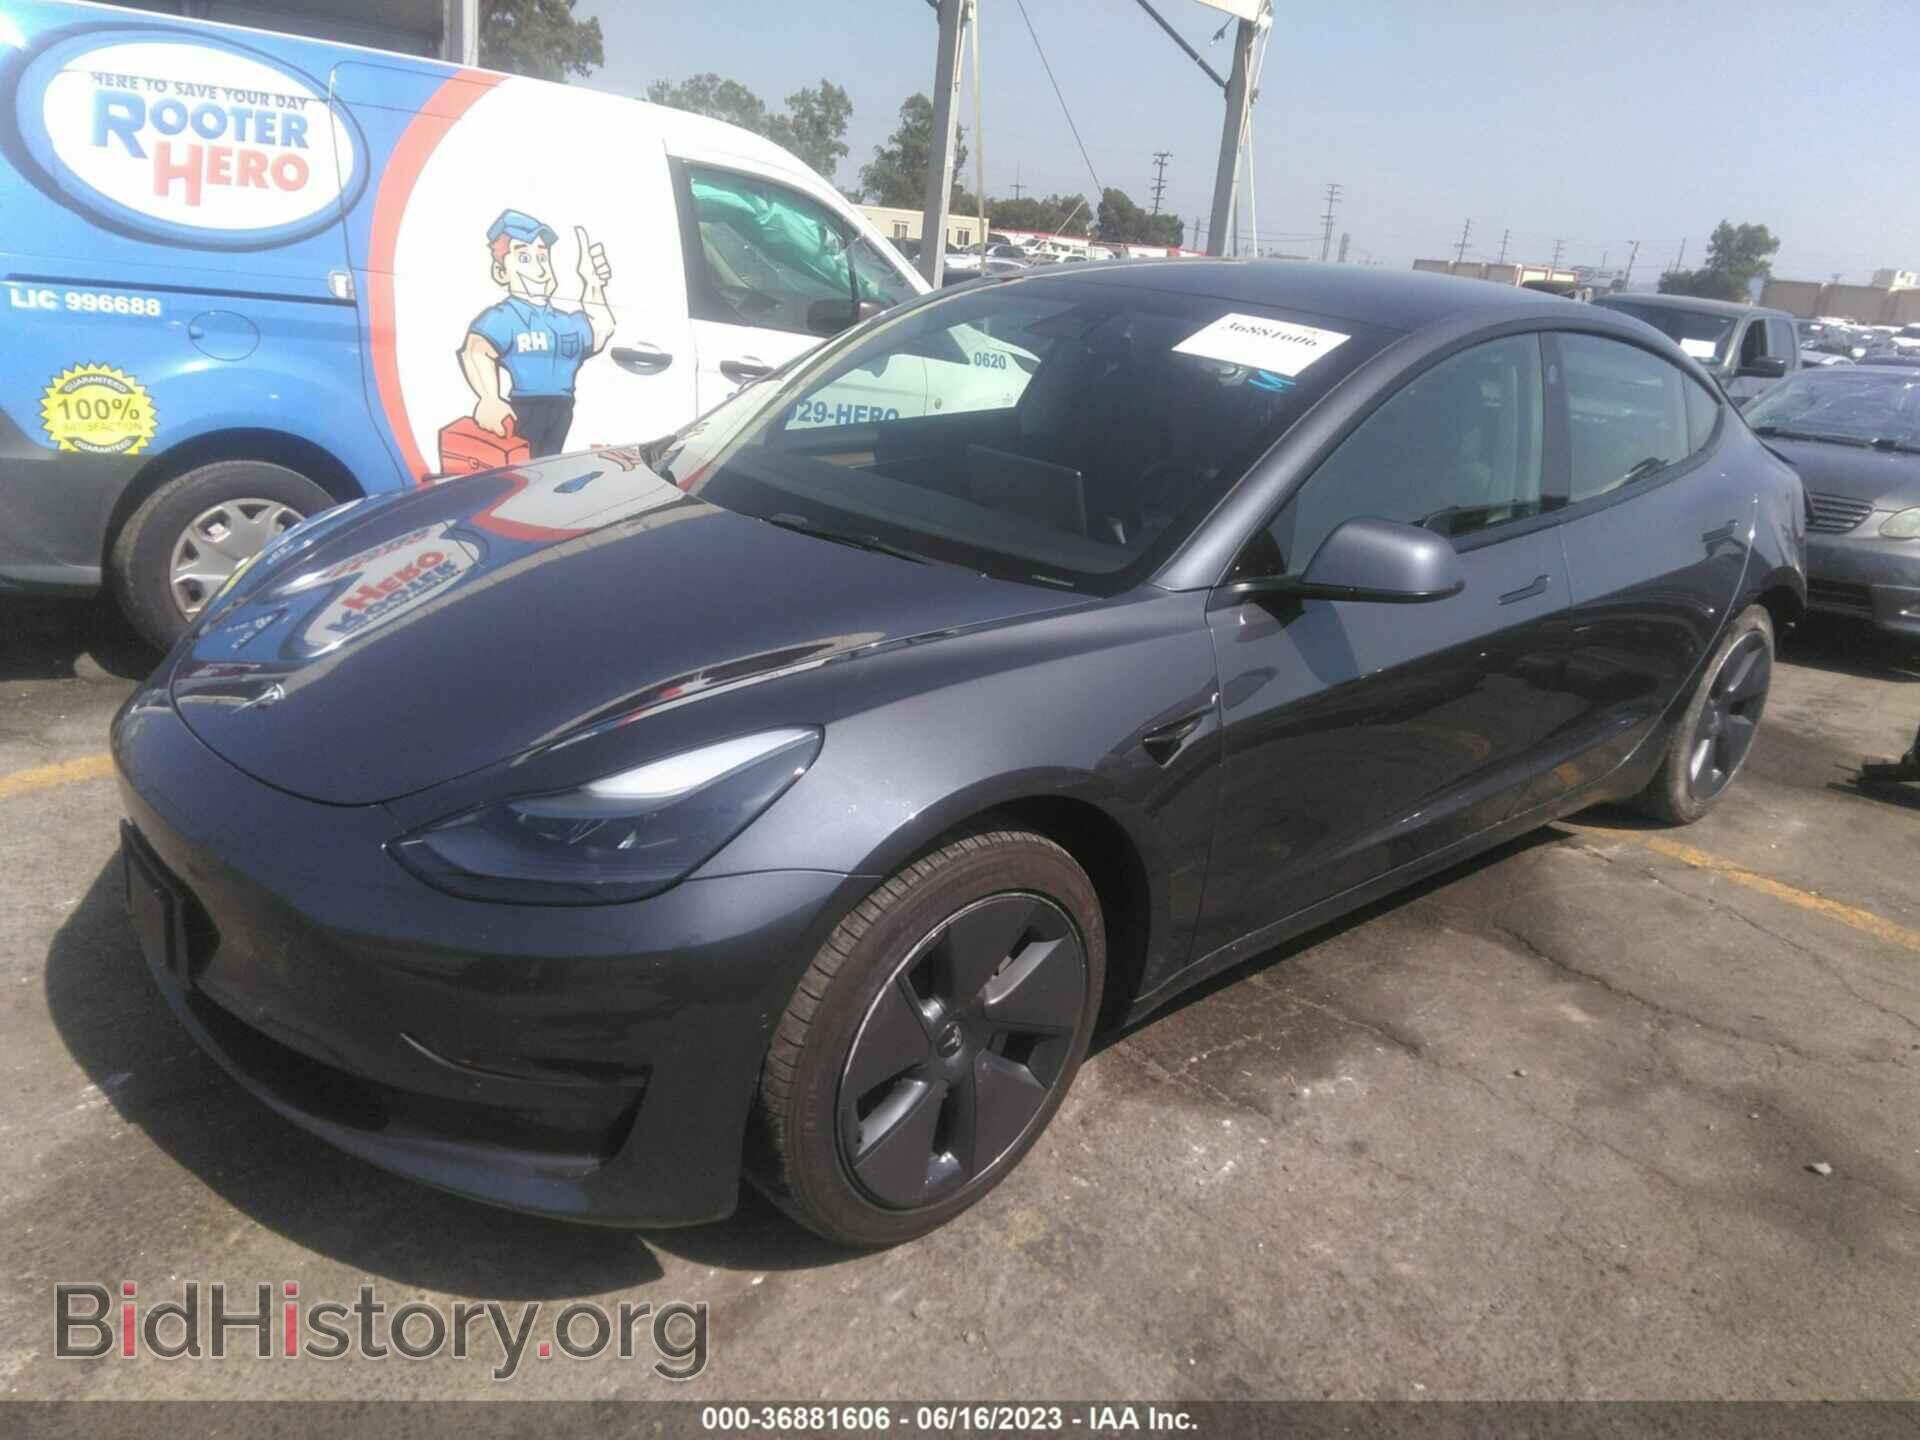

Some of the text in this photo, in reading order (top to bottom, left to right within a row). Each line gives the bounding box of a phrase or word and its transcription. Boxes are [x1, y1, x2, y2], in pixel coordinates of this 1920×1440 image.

[90, 71, 308, 112] HERE TO SAVE YOUR DAY
[90, 89, 310, 159] ROOTER
[153, 141, 310, 207] HERO
[10, 288, 162, 317] LIC 996688
[516, 332, 549, 353] RH
[973, 351, 1007, 370] 0620
[57, 398, 140, 420] 100%
